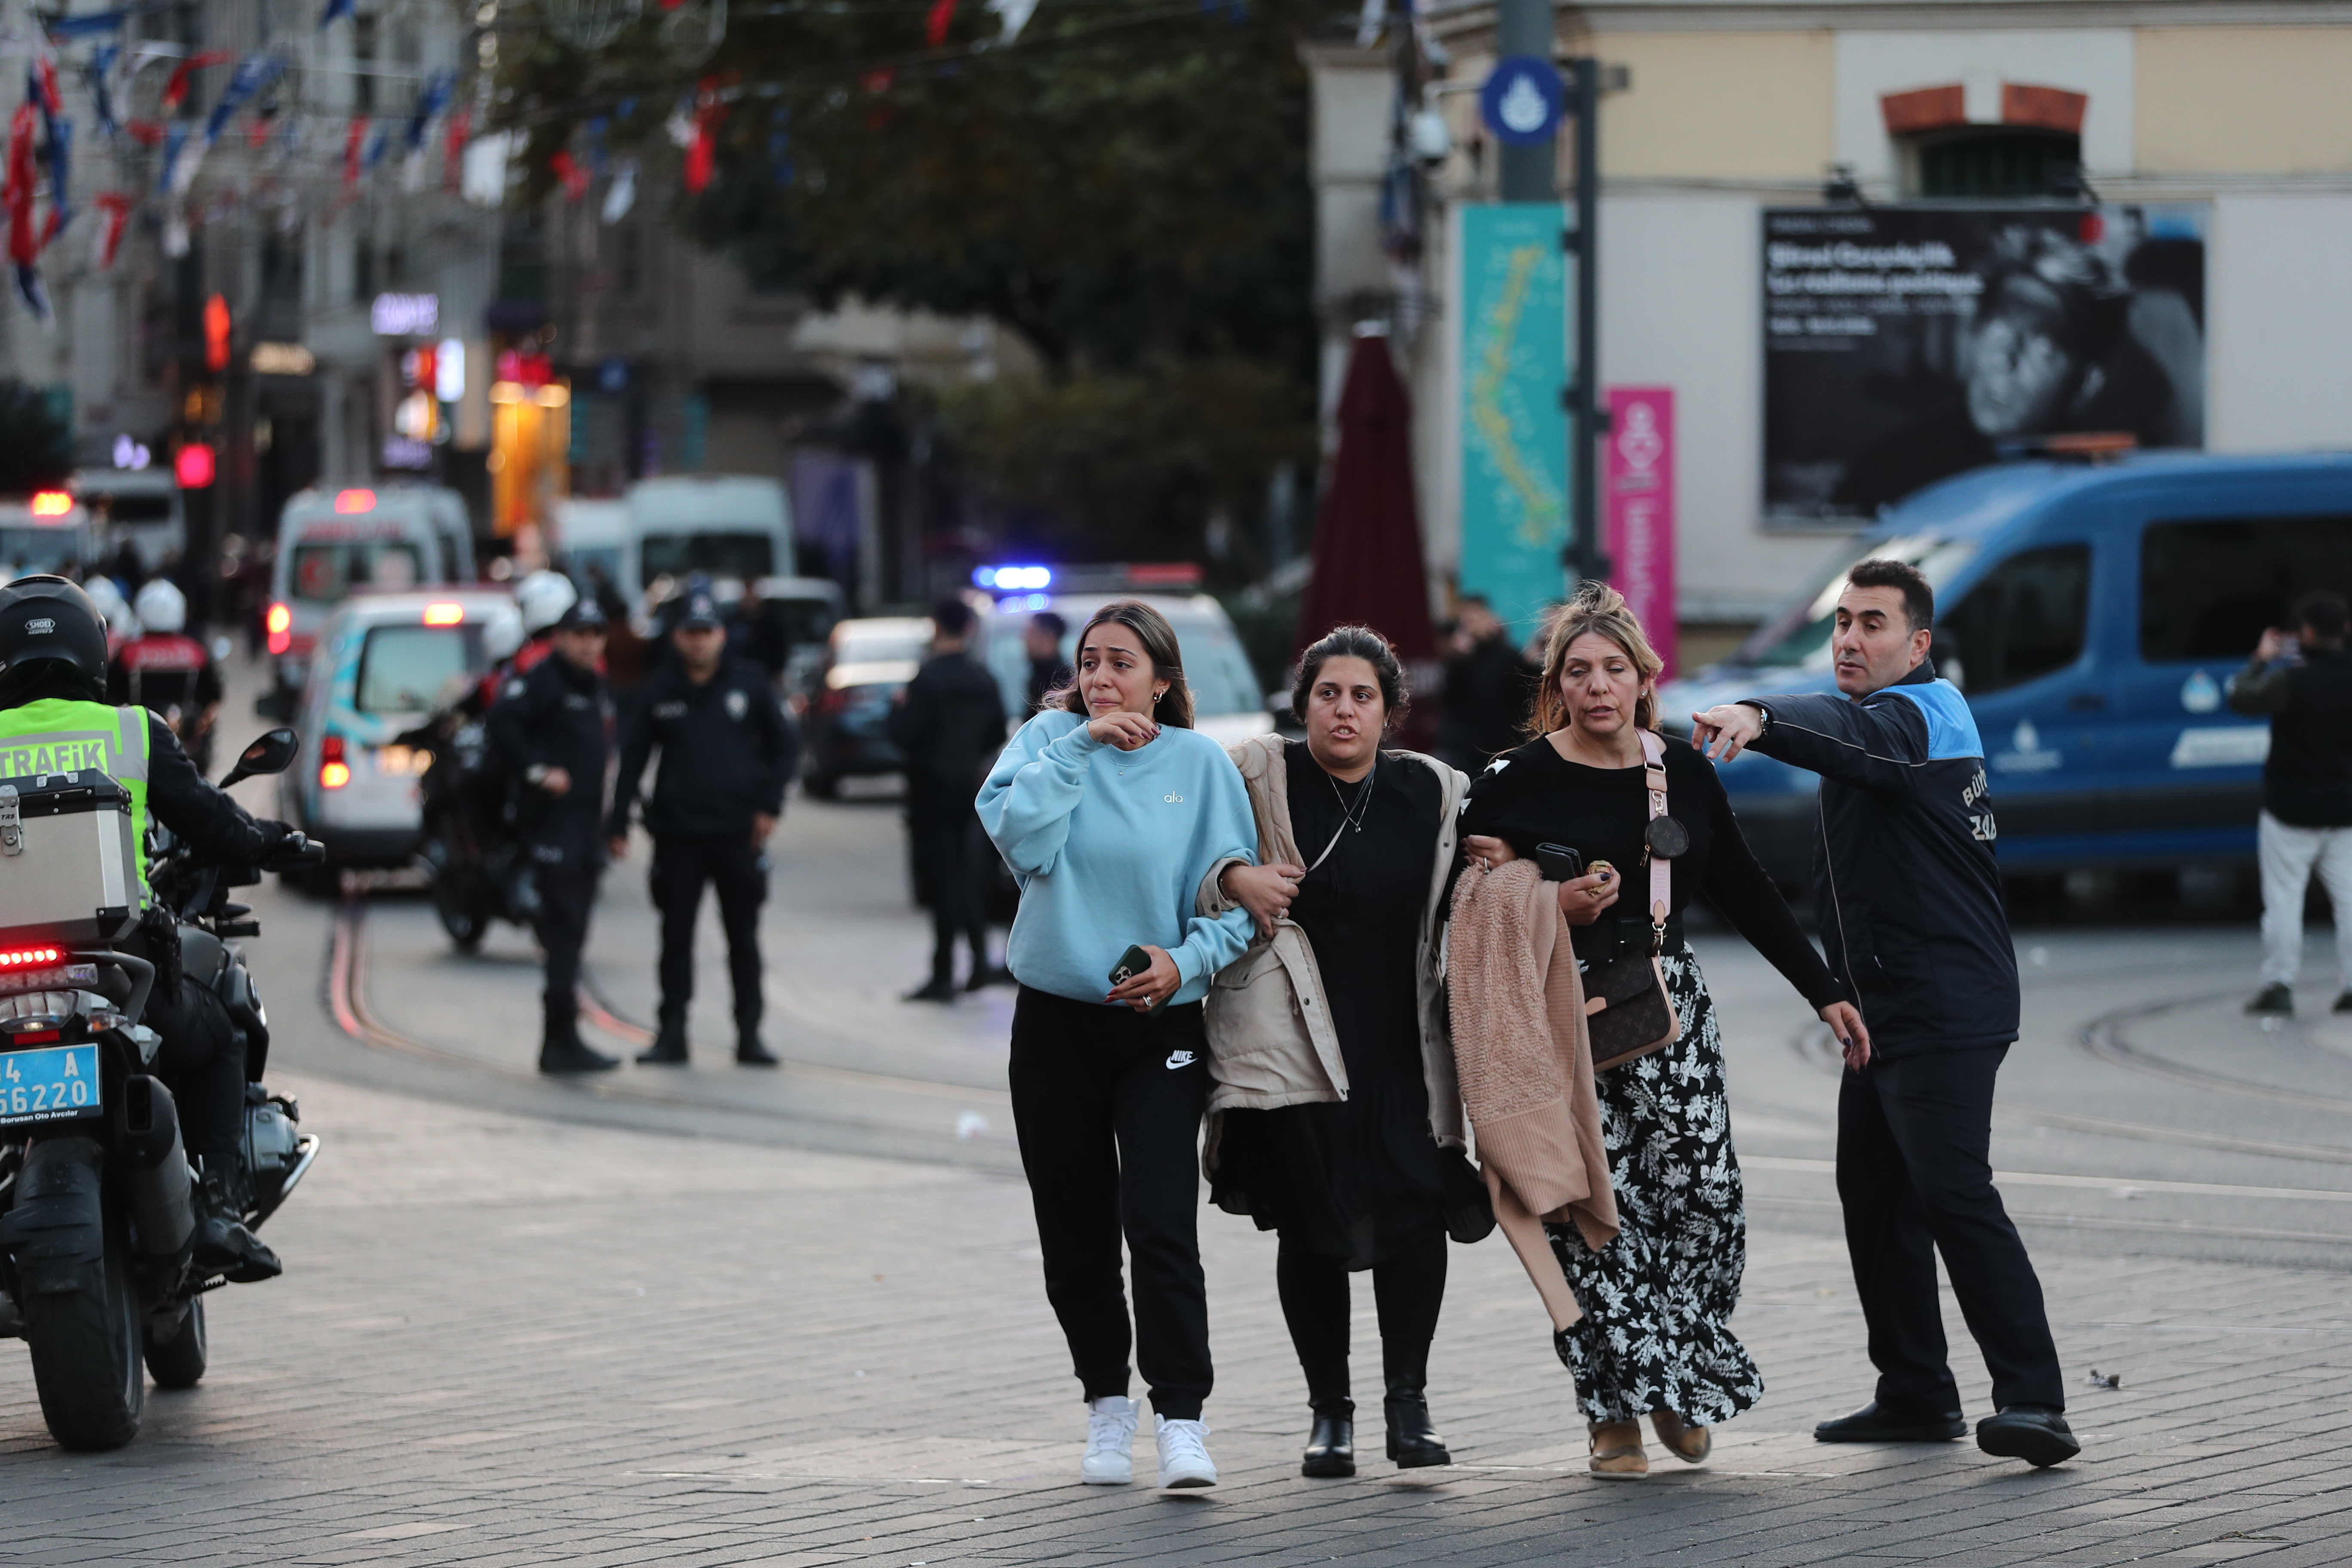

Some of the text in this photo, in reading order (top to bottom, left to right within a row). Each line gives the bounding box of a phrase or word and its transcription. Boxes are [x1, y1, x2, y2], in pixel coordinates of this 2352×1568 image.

[1164, 790, 1183, 803] alo
[1171, 1050, 1193, 1062] NIKE
[64, 1051, 79, 1078] A
[0, 1115, 34, 1124] Borusan
